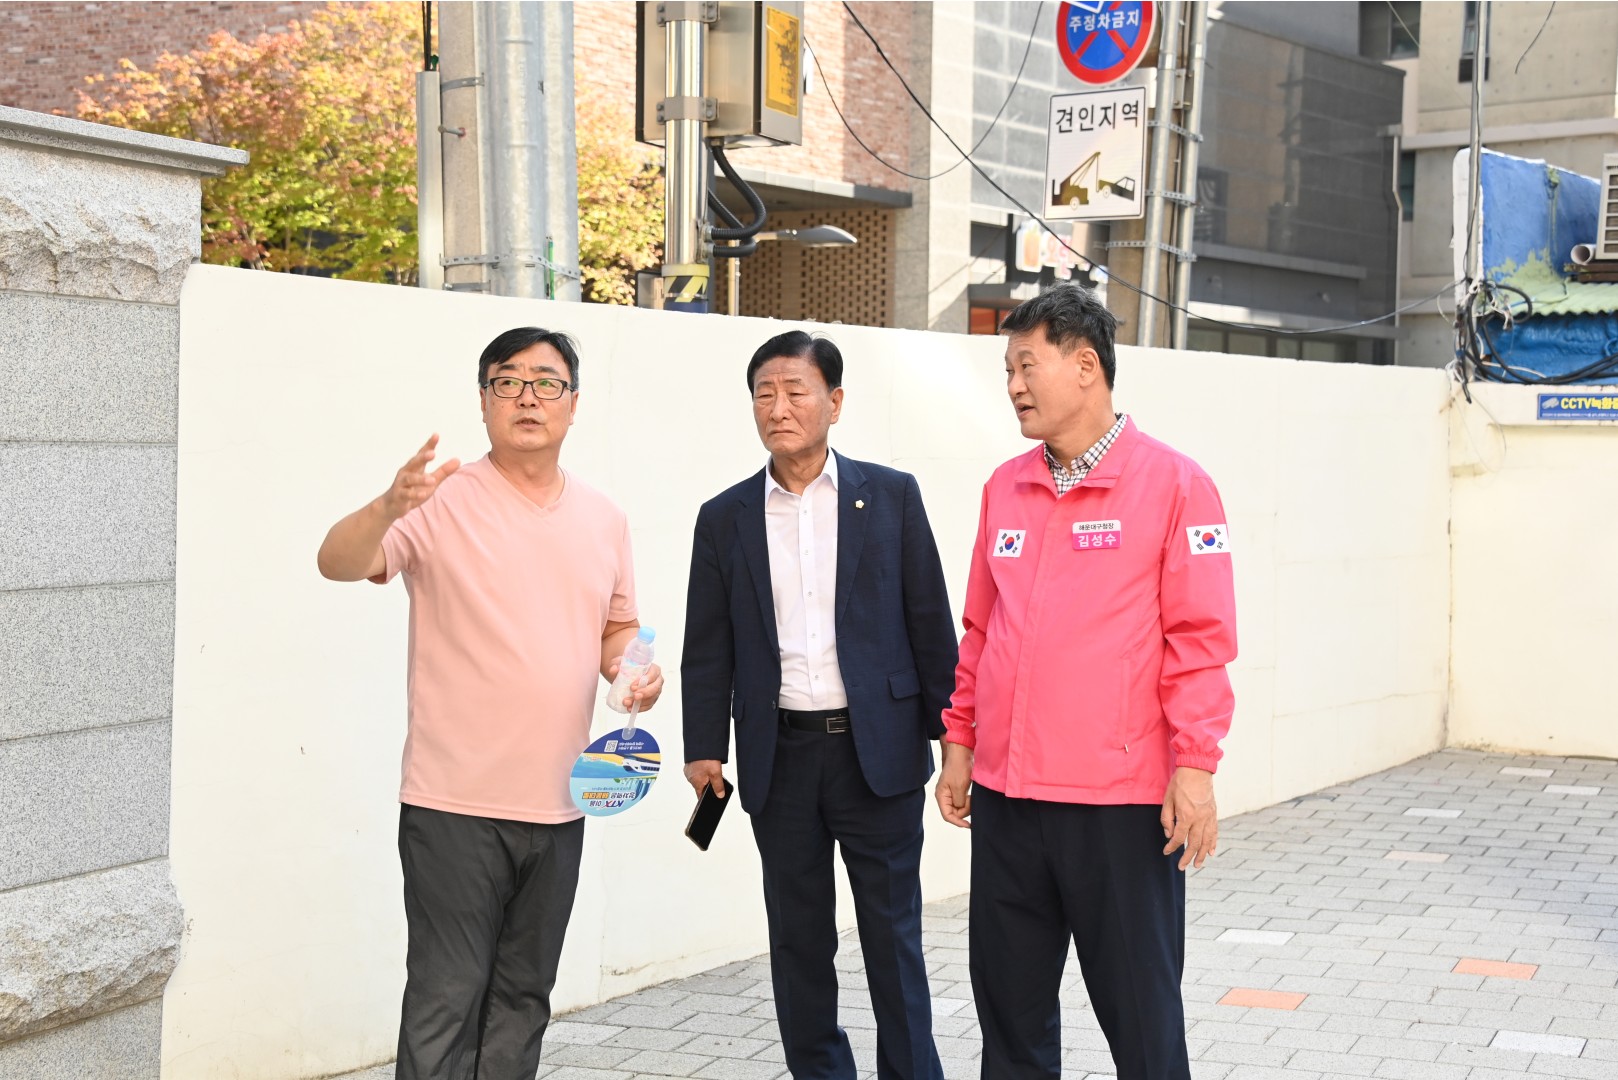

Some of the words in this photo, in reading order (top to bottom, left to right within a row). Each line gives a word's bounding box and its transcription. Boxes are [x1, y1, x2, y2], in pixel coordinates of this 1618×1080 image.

[1069, 9, 1139, 33] 주정차금지
[1056, 100, 1139, 133] 견인지역
[1079, 523, 1115, 531] 해운대구청장
[1078, 533, 1117, 548] 김성수
[603, 800, 624, 808] KTX
